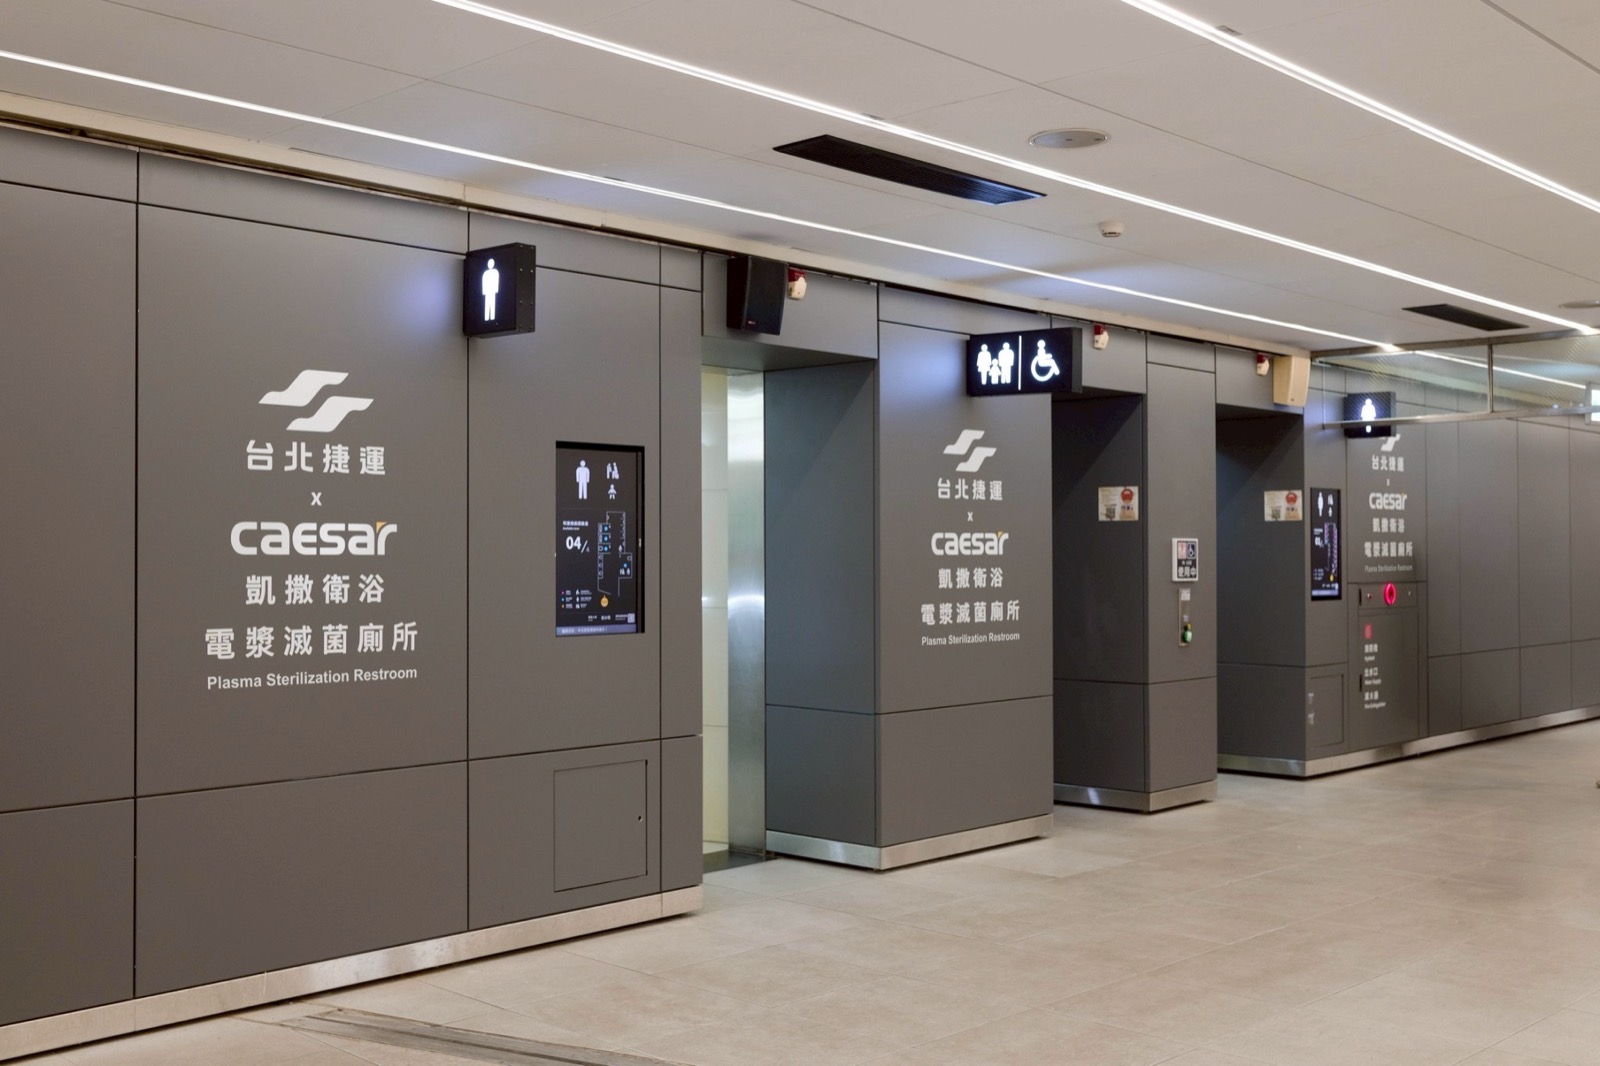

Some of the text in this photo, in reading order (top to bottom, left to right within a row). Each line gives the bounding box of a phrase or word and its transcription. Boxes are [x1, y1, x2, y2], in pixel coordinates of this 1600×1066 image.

[247, 440, 386, 475] 台北捷運
[937, 478, 1003, 500] 台北捷運
[246, 574, 385, 605] 凱撒衛浴
[938, 568, 1003, 589] 凱撒衛浴
[921, 600, 1020, 626] 電漿滅菌廁所
[205, 622, 418, 660] 電漿滅菌廁所
[921, 632, 1020, 646] Plasma Sterilization Restroom
[207, 668, 418, 690] Plasma Sterilization Restroom
